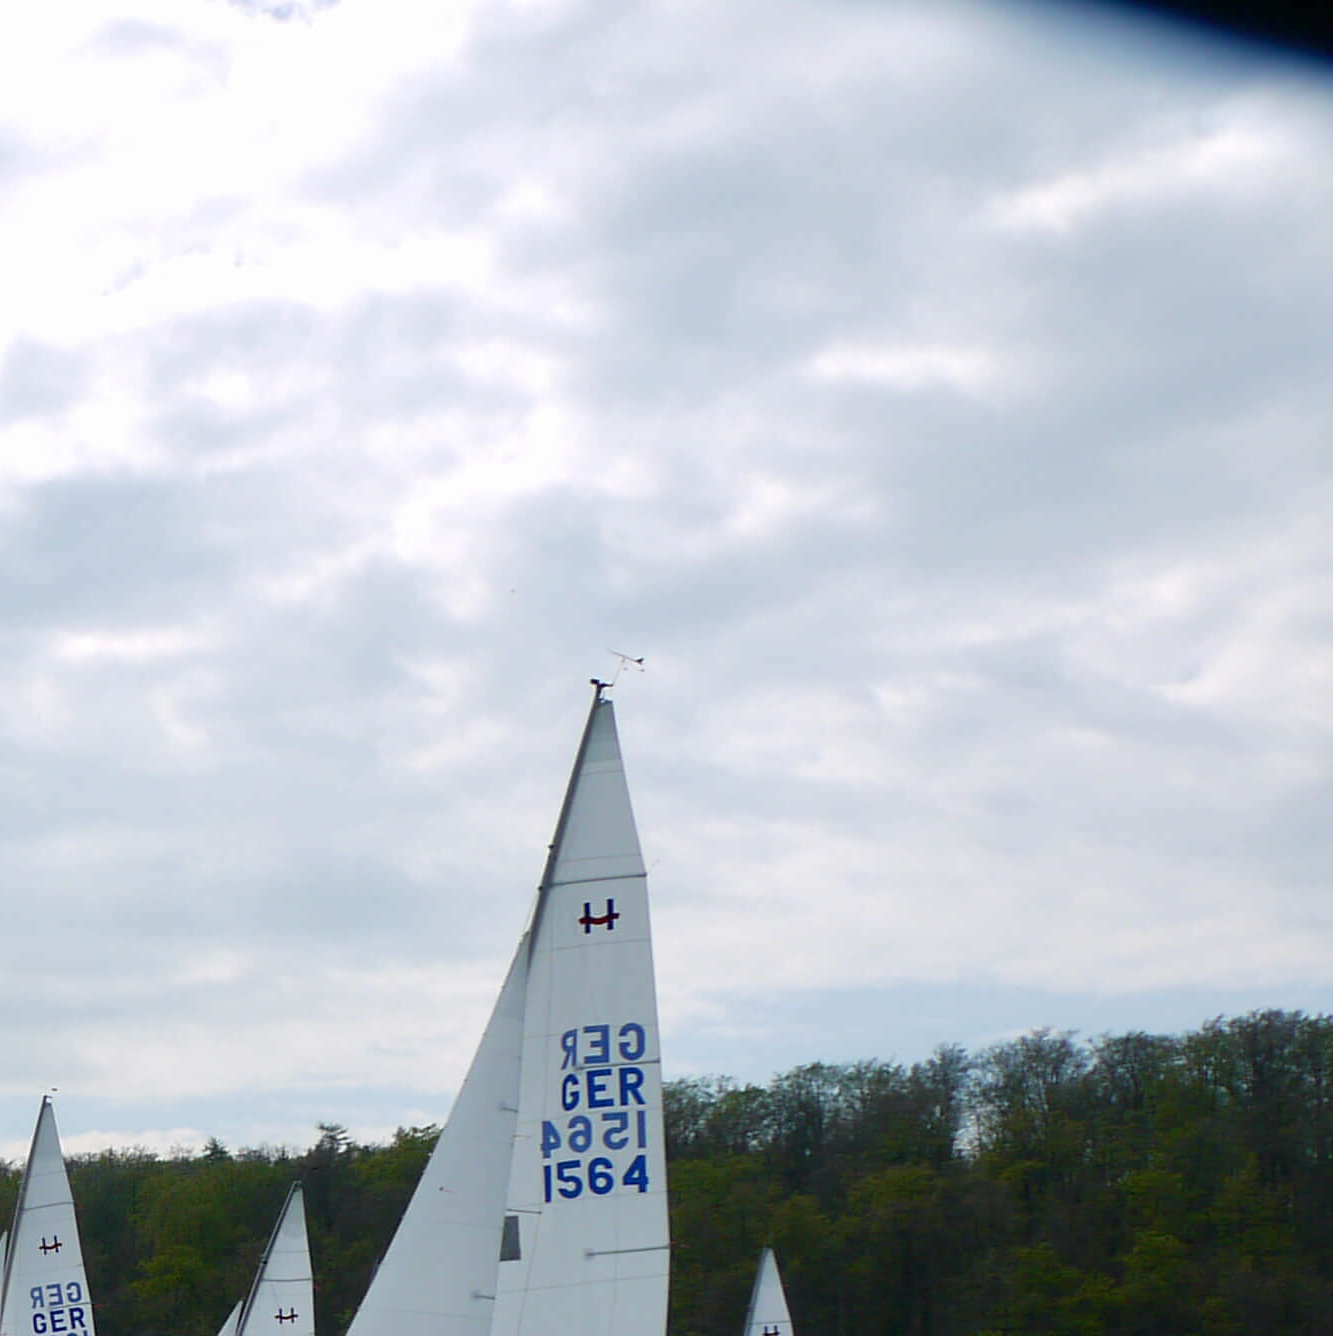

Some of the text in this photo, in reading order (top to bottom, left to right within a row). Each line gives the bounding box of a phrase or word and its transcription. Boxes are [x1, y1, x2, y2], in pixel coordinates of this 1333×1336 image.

[562, 1067, 646, 1112] GER
[543, 1155, 648, 1203] 1564
[33, 1307, 85, 1334] GER
